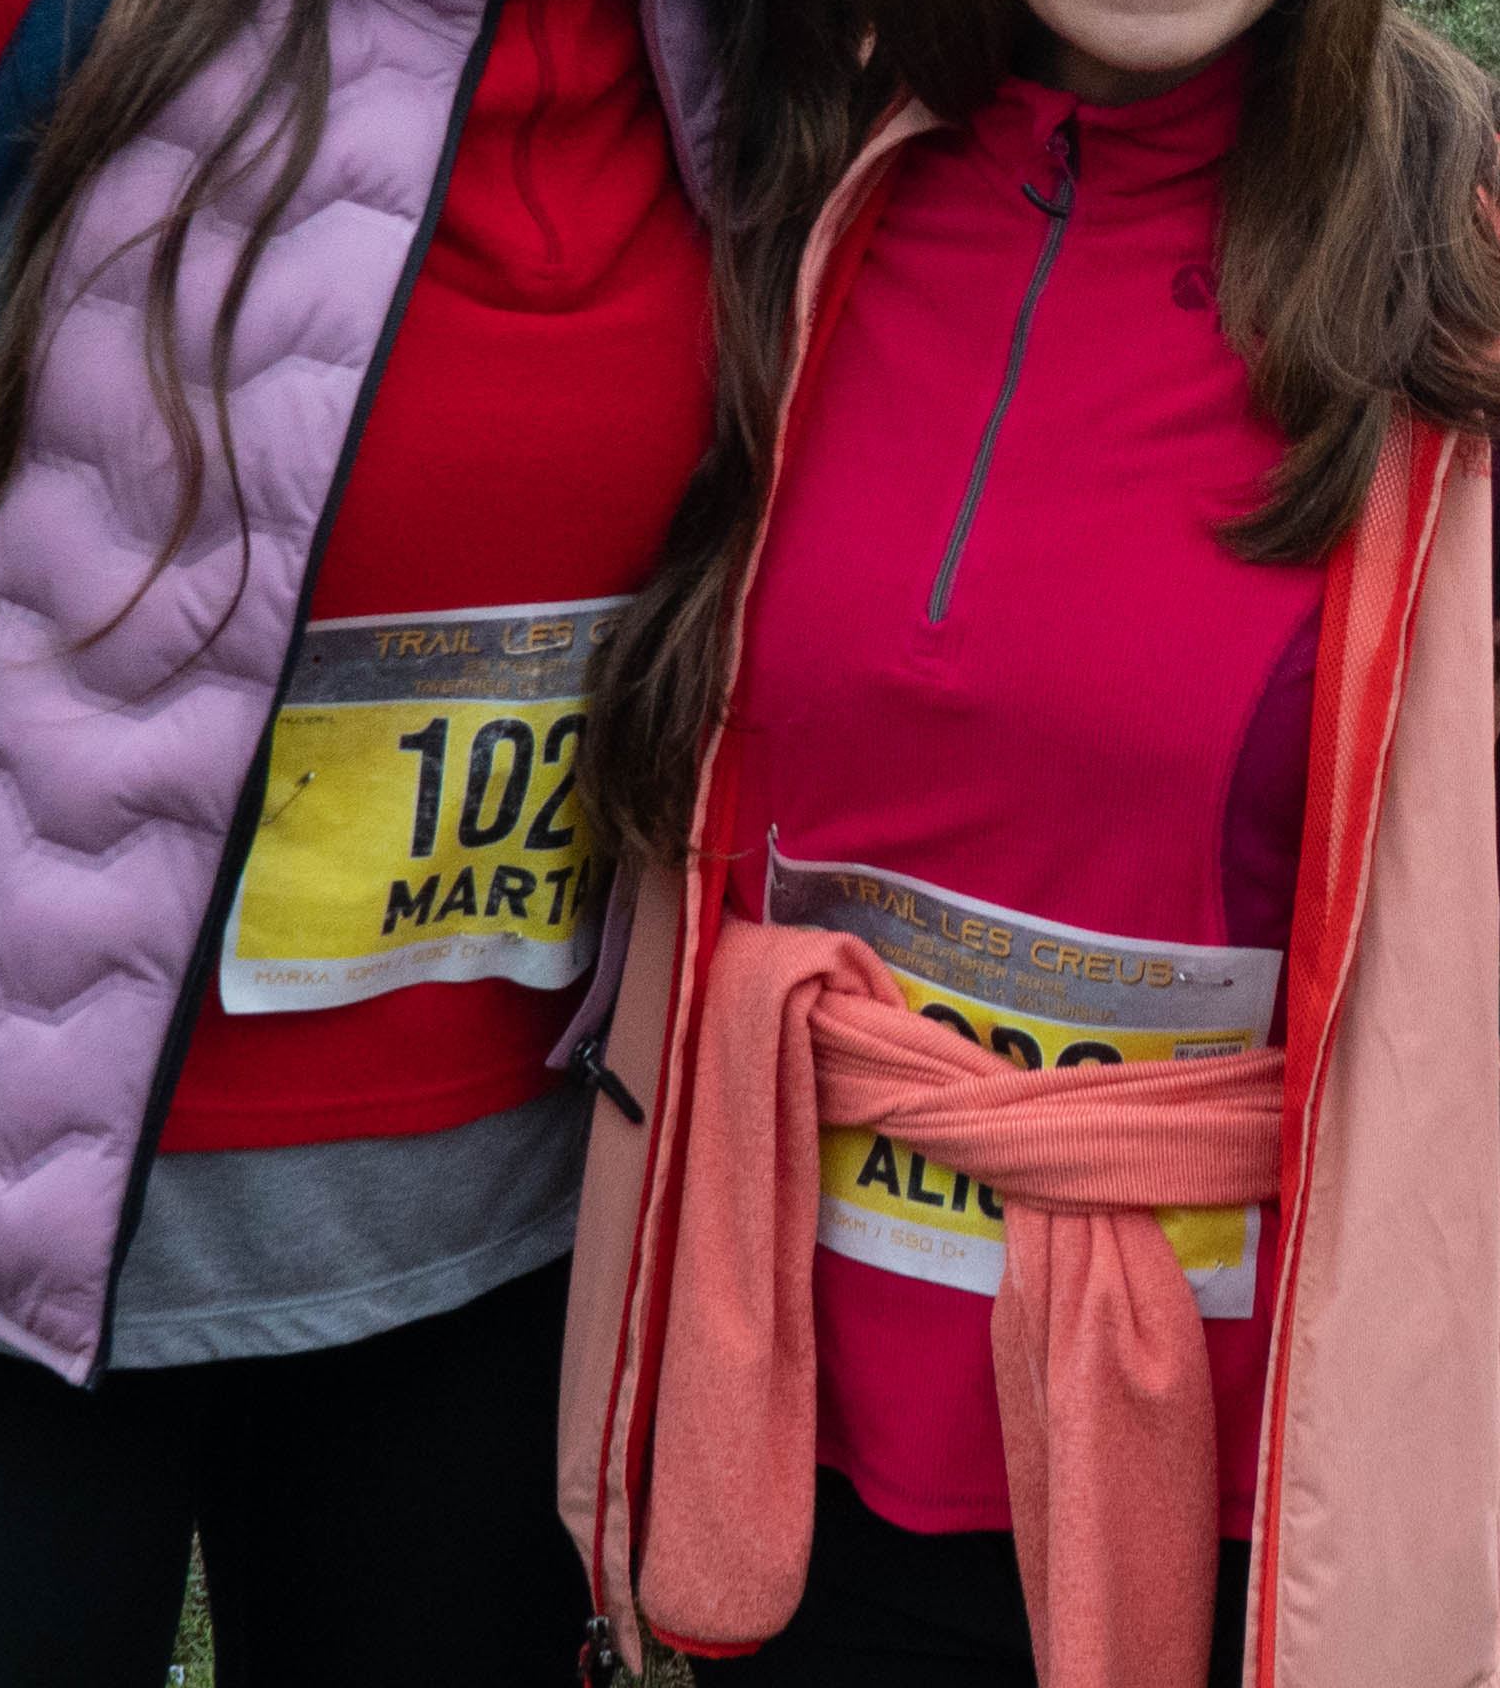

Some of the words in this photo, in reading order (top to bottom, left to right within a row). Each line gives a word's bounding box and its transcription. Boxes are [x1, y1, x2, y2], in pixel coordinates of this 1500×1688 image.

[375, 627, 482, 657] TRAIL
[502, 621, 573, 654] LES
[833, 873, 928, 928] TRAIL
[941, 910, 1013, 959] LES
[1030, 939, 1174, 988] CREUS
